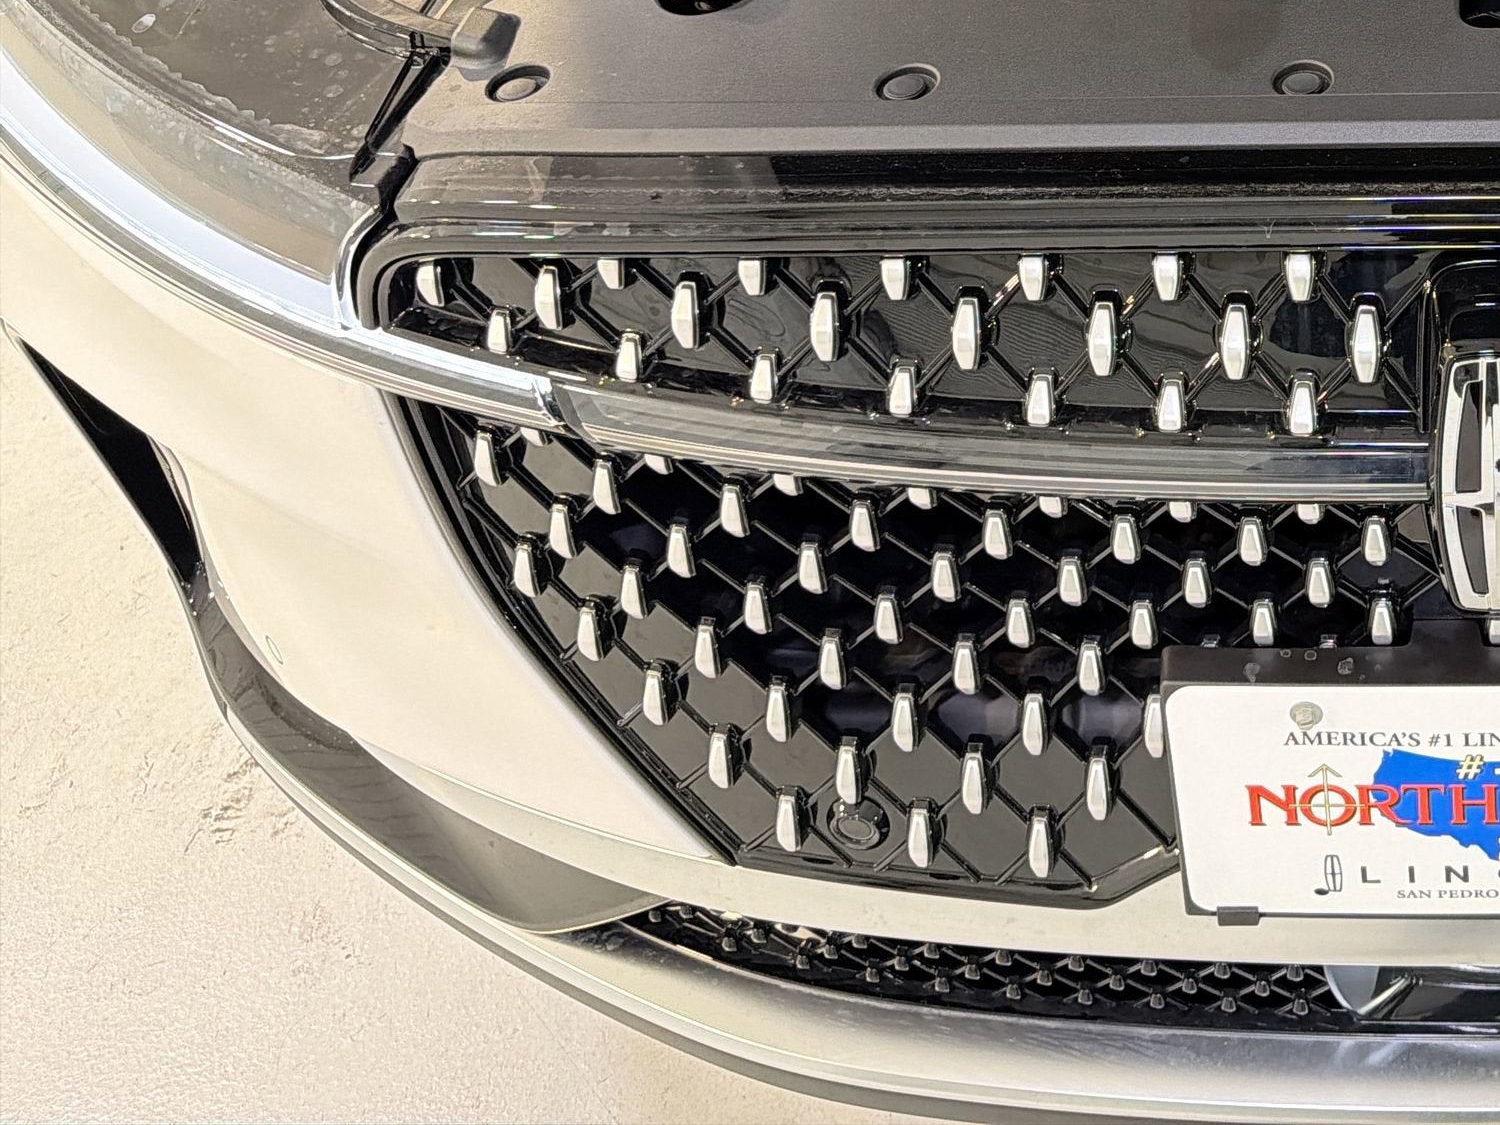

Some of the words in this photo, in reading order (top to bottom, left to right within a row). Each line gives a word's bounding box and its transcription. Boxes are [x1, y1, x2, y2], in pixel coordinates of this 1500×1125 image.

[1283, 730, 1421, 747] AMERICA'S
[1427, 733, 1453, 747] #1
[1245, 782, 1499, 828] NORTH
[1397, 889, 1432, 898] SAN
[1438, 889, 1499, 898] PEDRO
